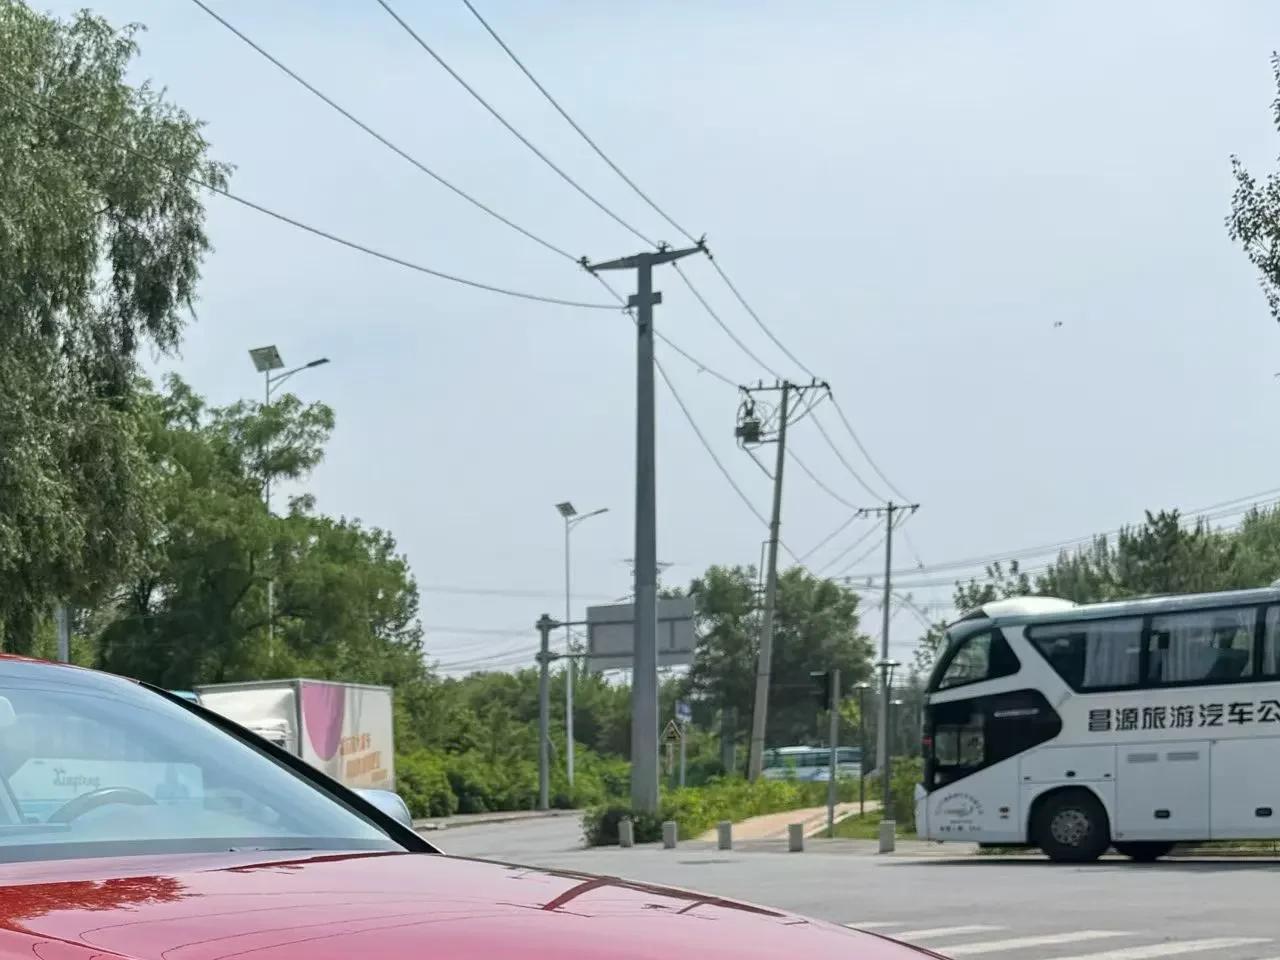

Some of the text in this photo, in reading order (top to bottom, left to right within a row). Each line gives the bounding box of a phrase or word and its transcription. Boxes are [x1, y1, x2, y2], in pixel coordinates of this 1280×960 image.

[1088, 699, 1280, 732] 昌源旅游汽车公
